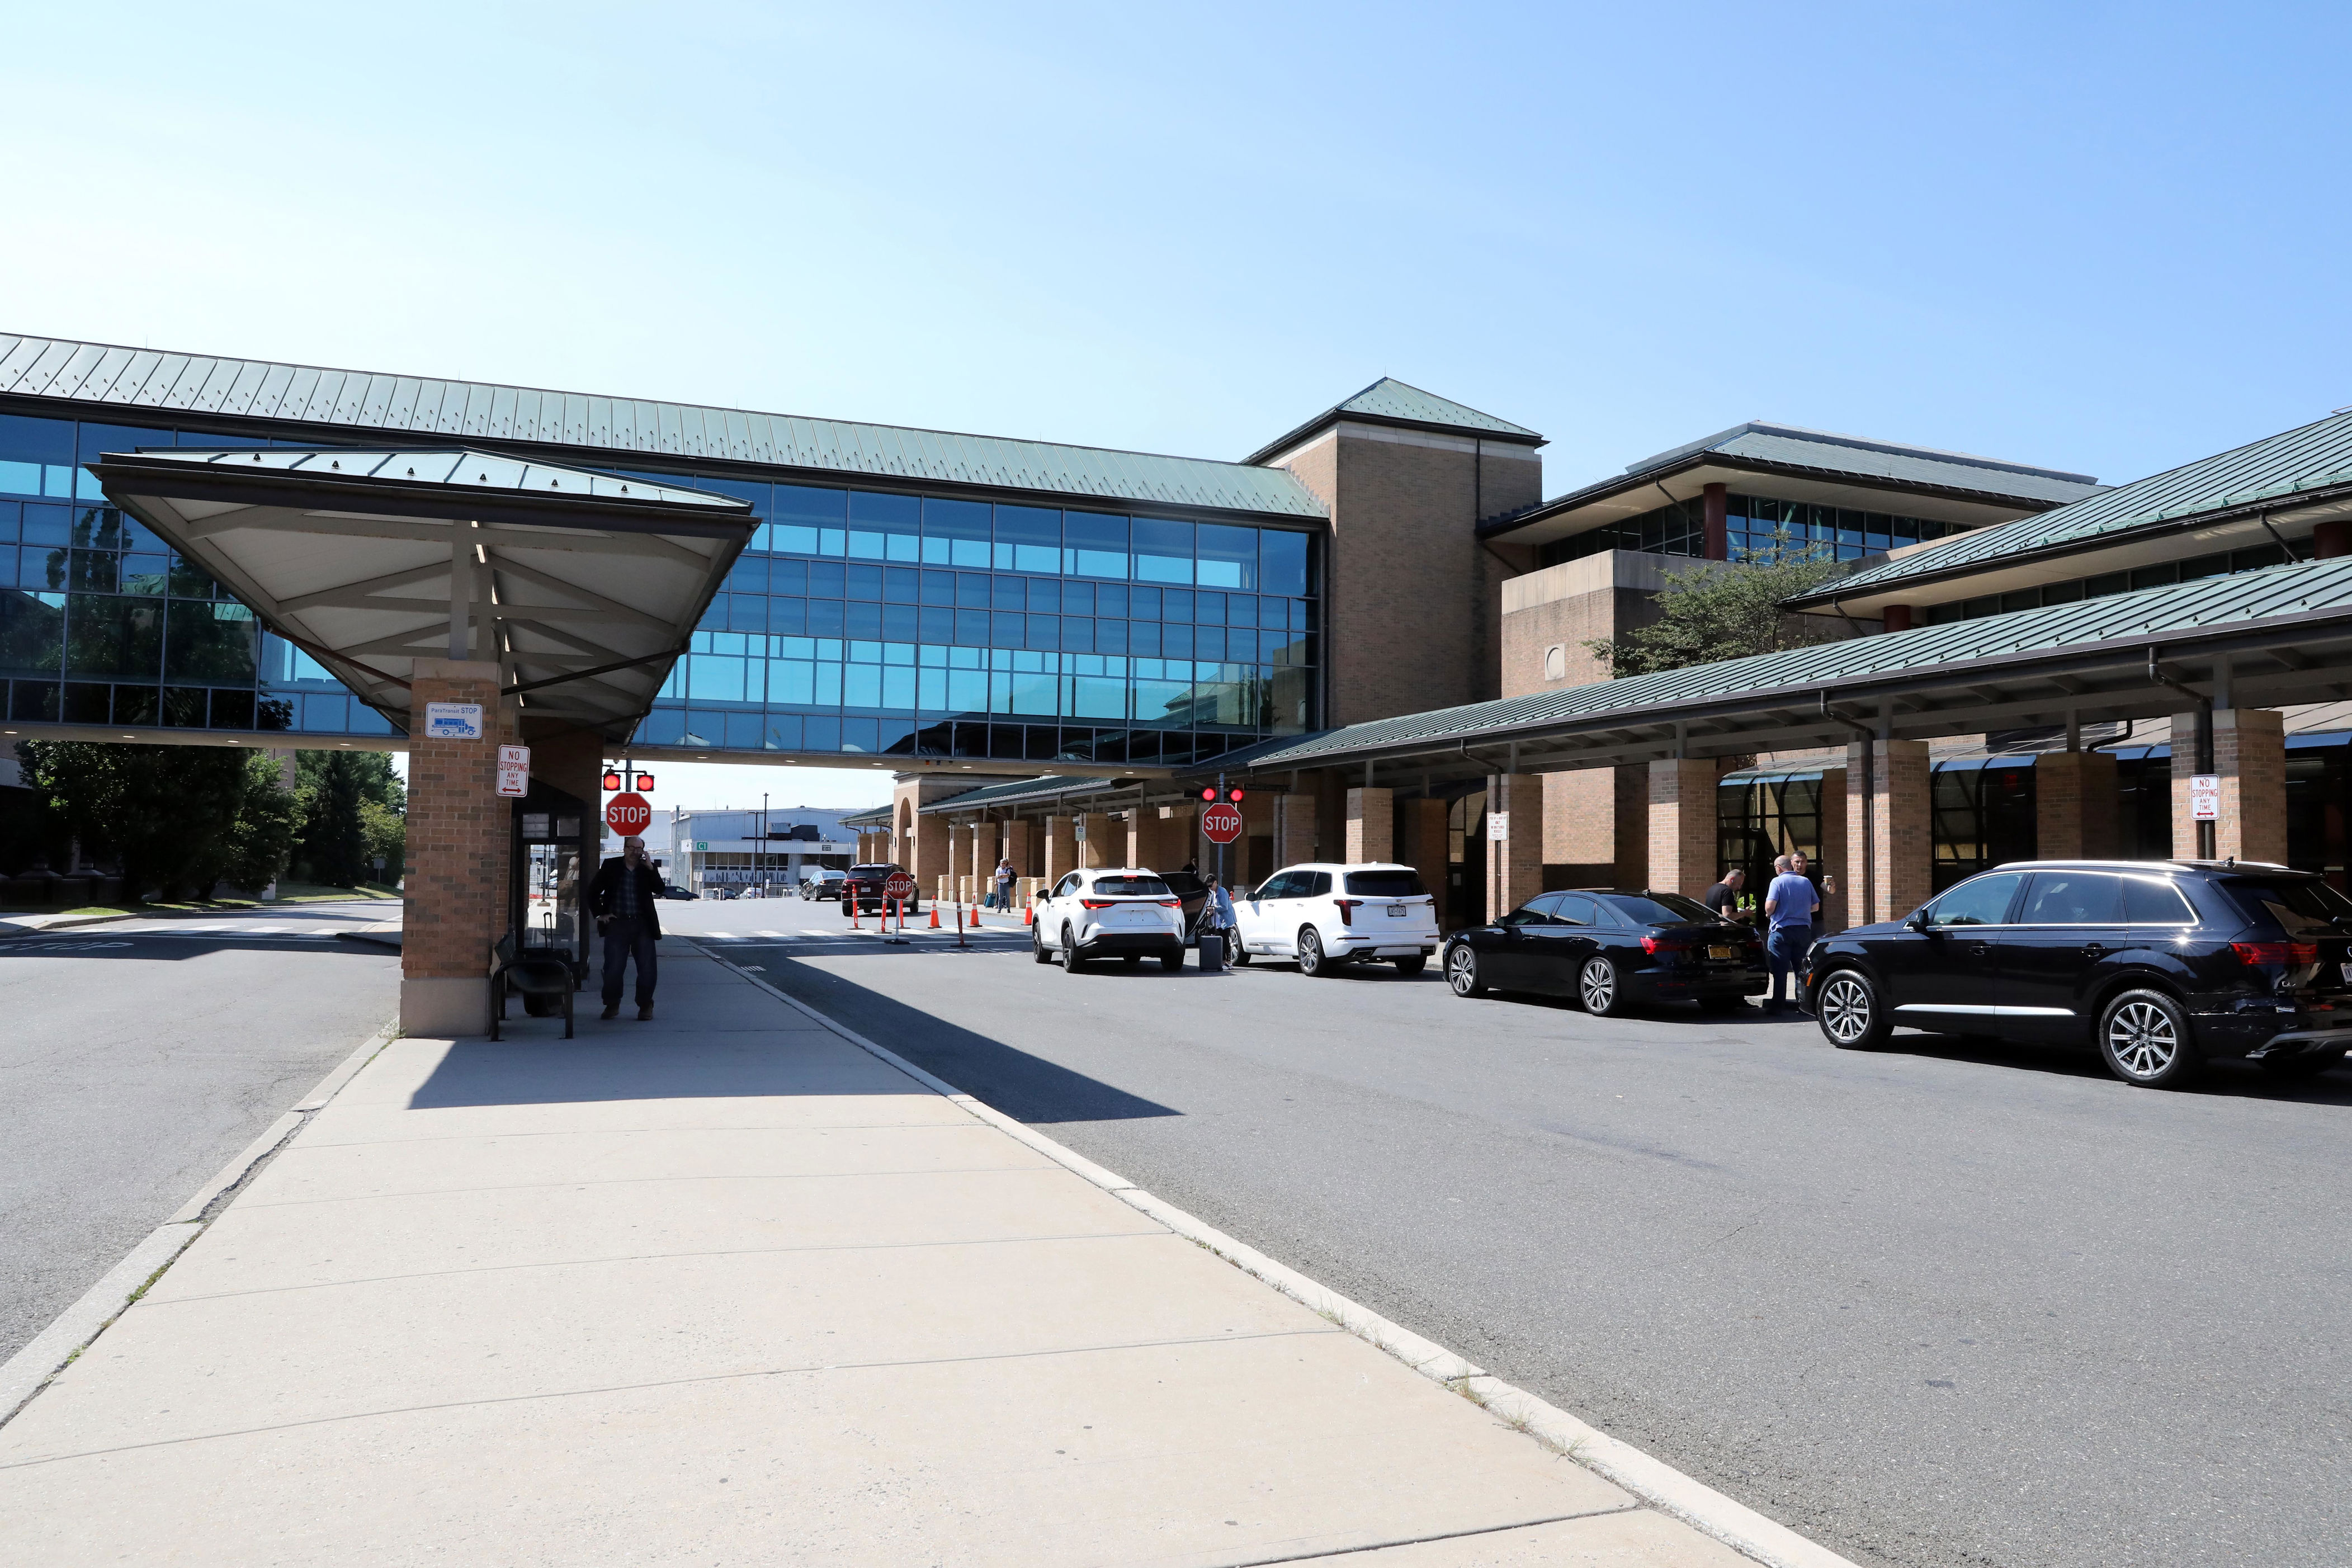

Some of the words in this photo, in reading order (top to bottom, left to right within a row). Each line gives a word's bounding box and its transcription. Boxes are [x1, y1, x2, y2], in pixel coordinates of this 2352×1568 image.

[508, 751, 519, 760] NO
[500, 761, 527, 772] STOPPING
[2199, 779, 2210, 787] NO
[2192, 788, 2218, 797] STOPPING
[609, 806, 649, 823] STOP
[1205, 816, 1239, 831] STOP
[888, 881, 911, 891] STOP
